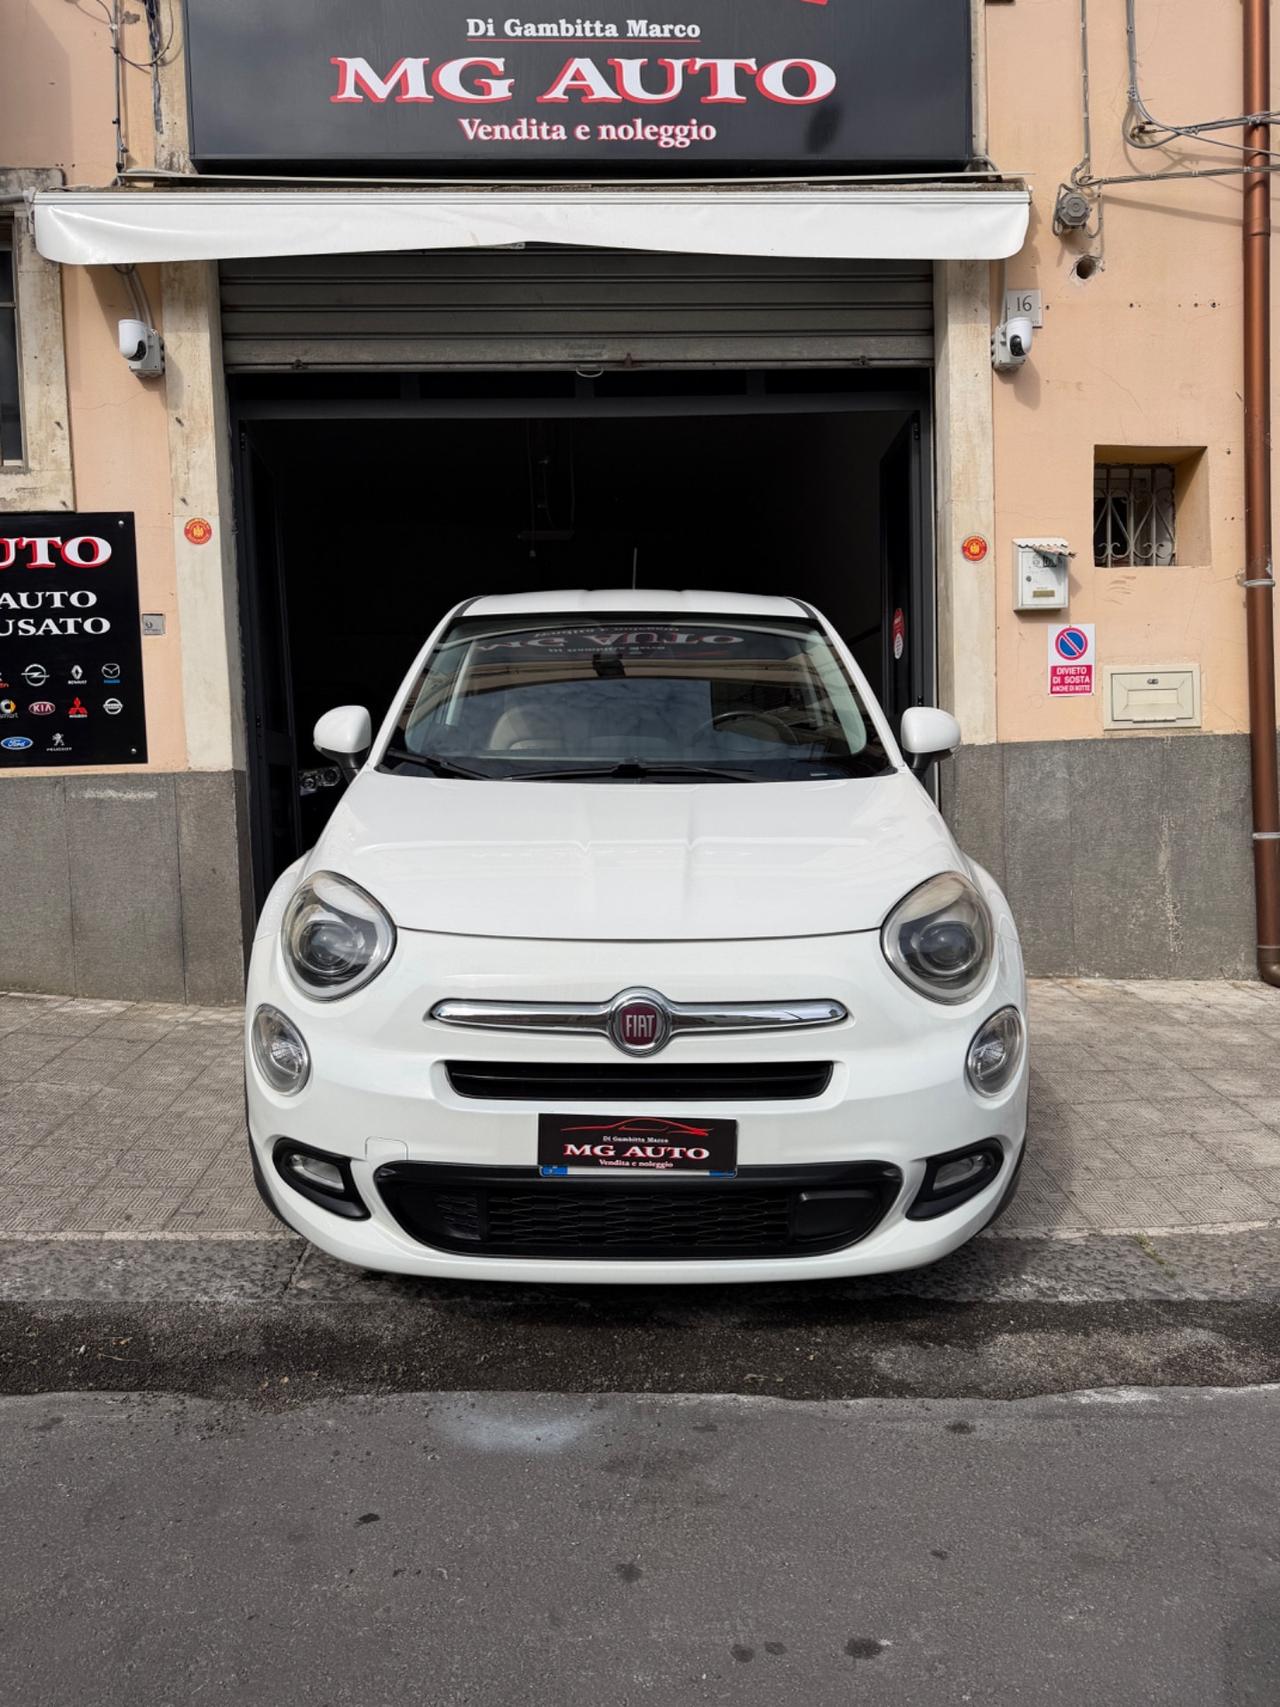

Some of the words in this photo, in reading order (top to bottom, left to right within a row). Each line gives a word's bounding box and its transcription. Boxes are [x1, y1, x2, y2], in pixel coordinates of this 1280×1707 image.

[466, 18, 496, 37] Di
[503, 18, 619, 38] Gambitta
[626, 19, 701, 38] Marco
[330, 57, 515, 103] MG
[536, 57, 837, 105] AUTO
[457, 118, 567, 141] Vendita
[574, 123, 591, 141] e
[597, 118, 717, 148] noleggio
[1016, 295, 1033, 312] 16
[0, 590, 97, 610] AUTO
[1052, 676, 1061, 684] DI
[1064, 676, 1090, 684] SOSTA
[1056, 667, 1087, 675] DIVIETO
[625, 1014, 655, 1038] FIAT
[563, 1143, 616, 1157] MG
[623, 1145, 710, 1160] AUTO
[599, 1158, 630, 1167] Vendita
[638, 1160, 674, 1169] noleggio
